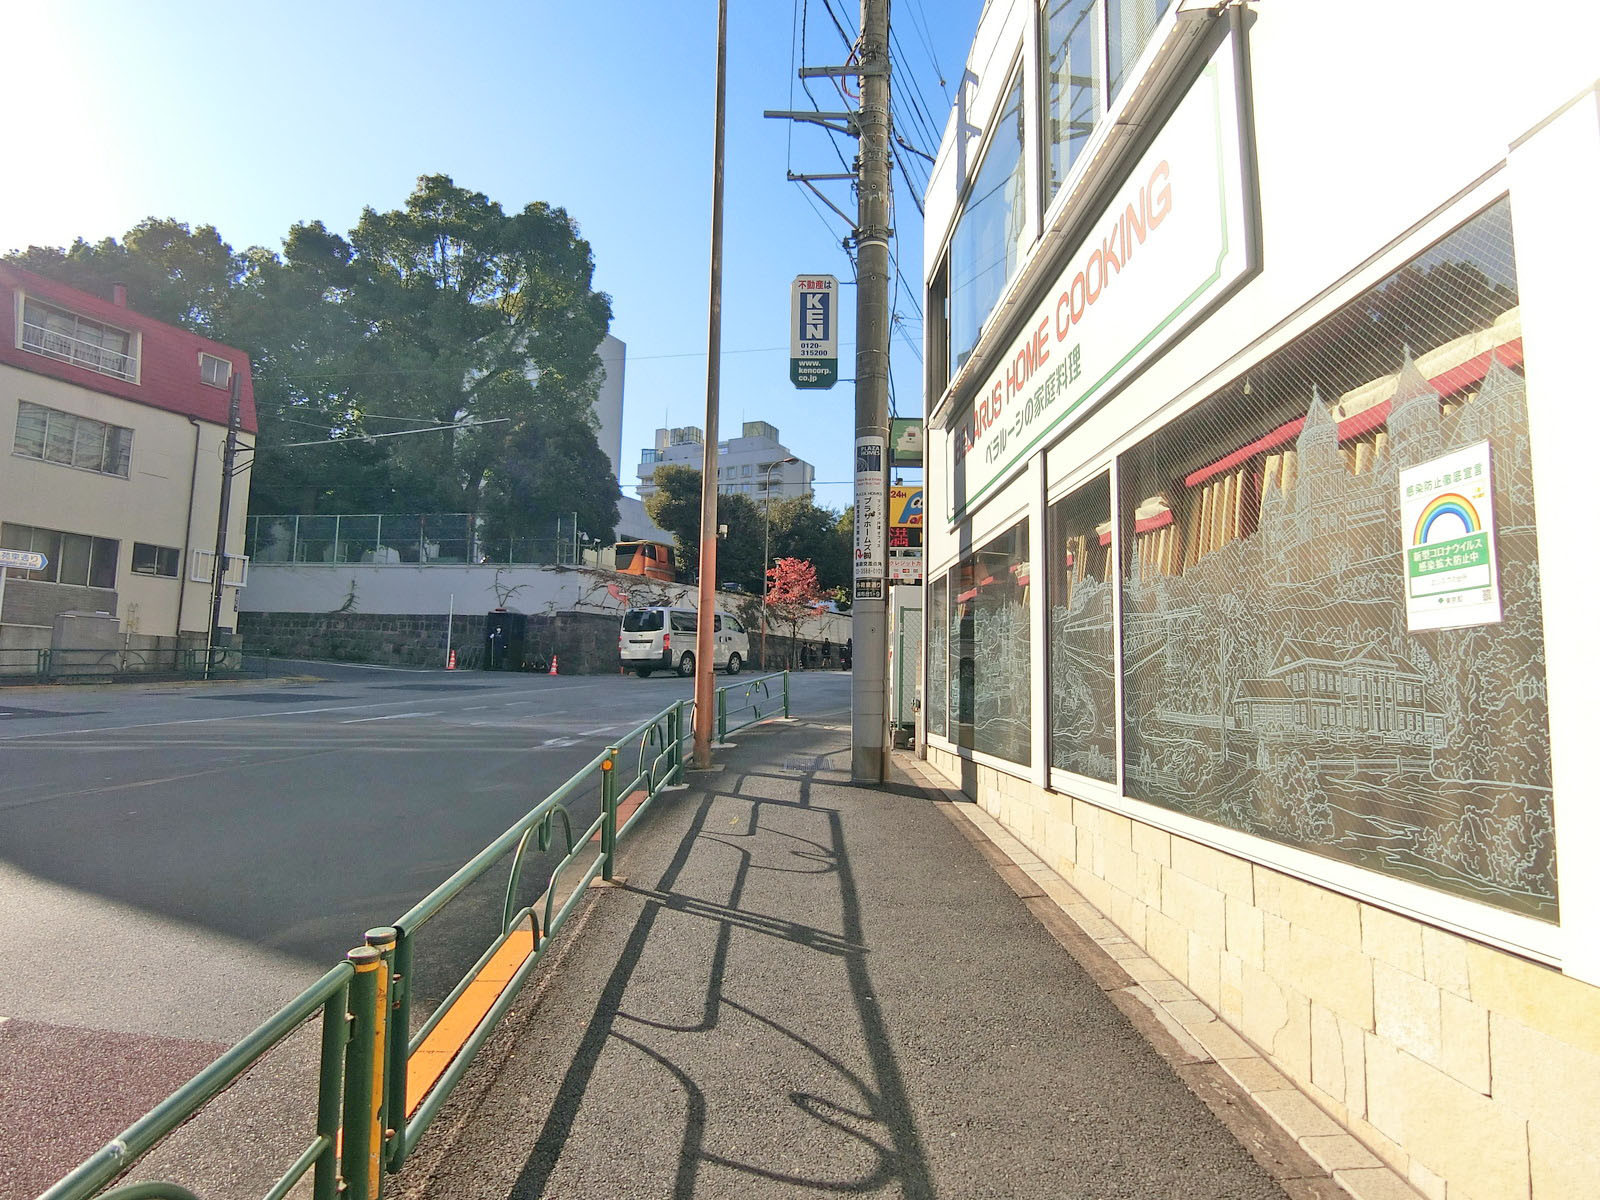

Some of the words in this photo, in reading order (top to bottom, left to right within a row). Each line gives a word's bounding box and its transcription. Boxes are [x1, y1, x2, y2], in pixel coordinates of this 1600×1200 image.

[798, 280, 832, 290] 不動産は
[1006, 316, 1050, 405] HOME
[1055, 159, 1172, 343] COOKING
[806, 293, 824, 339] KEN
[798, 367, 831, 375] kencorp.
[985, 343, 1082, 465] ベラルーシの家庭料理
[1406, 463, 1483, 497] 感染防止徹底宣言
[890, 490, 907, 498] 24H
[1413, 538, 1483, 563] 新型コロナウイルス
[1418, 550, 1480, 573] 感染拡大防止中
